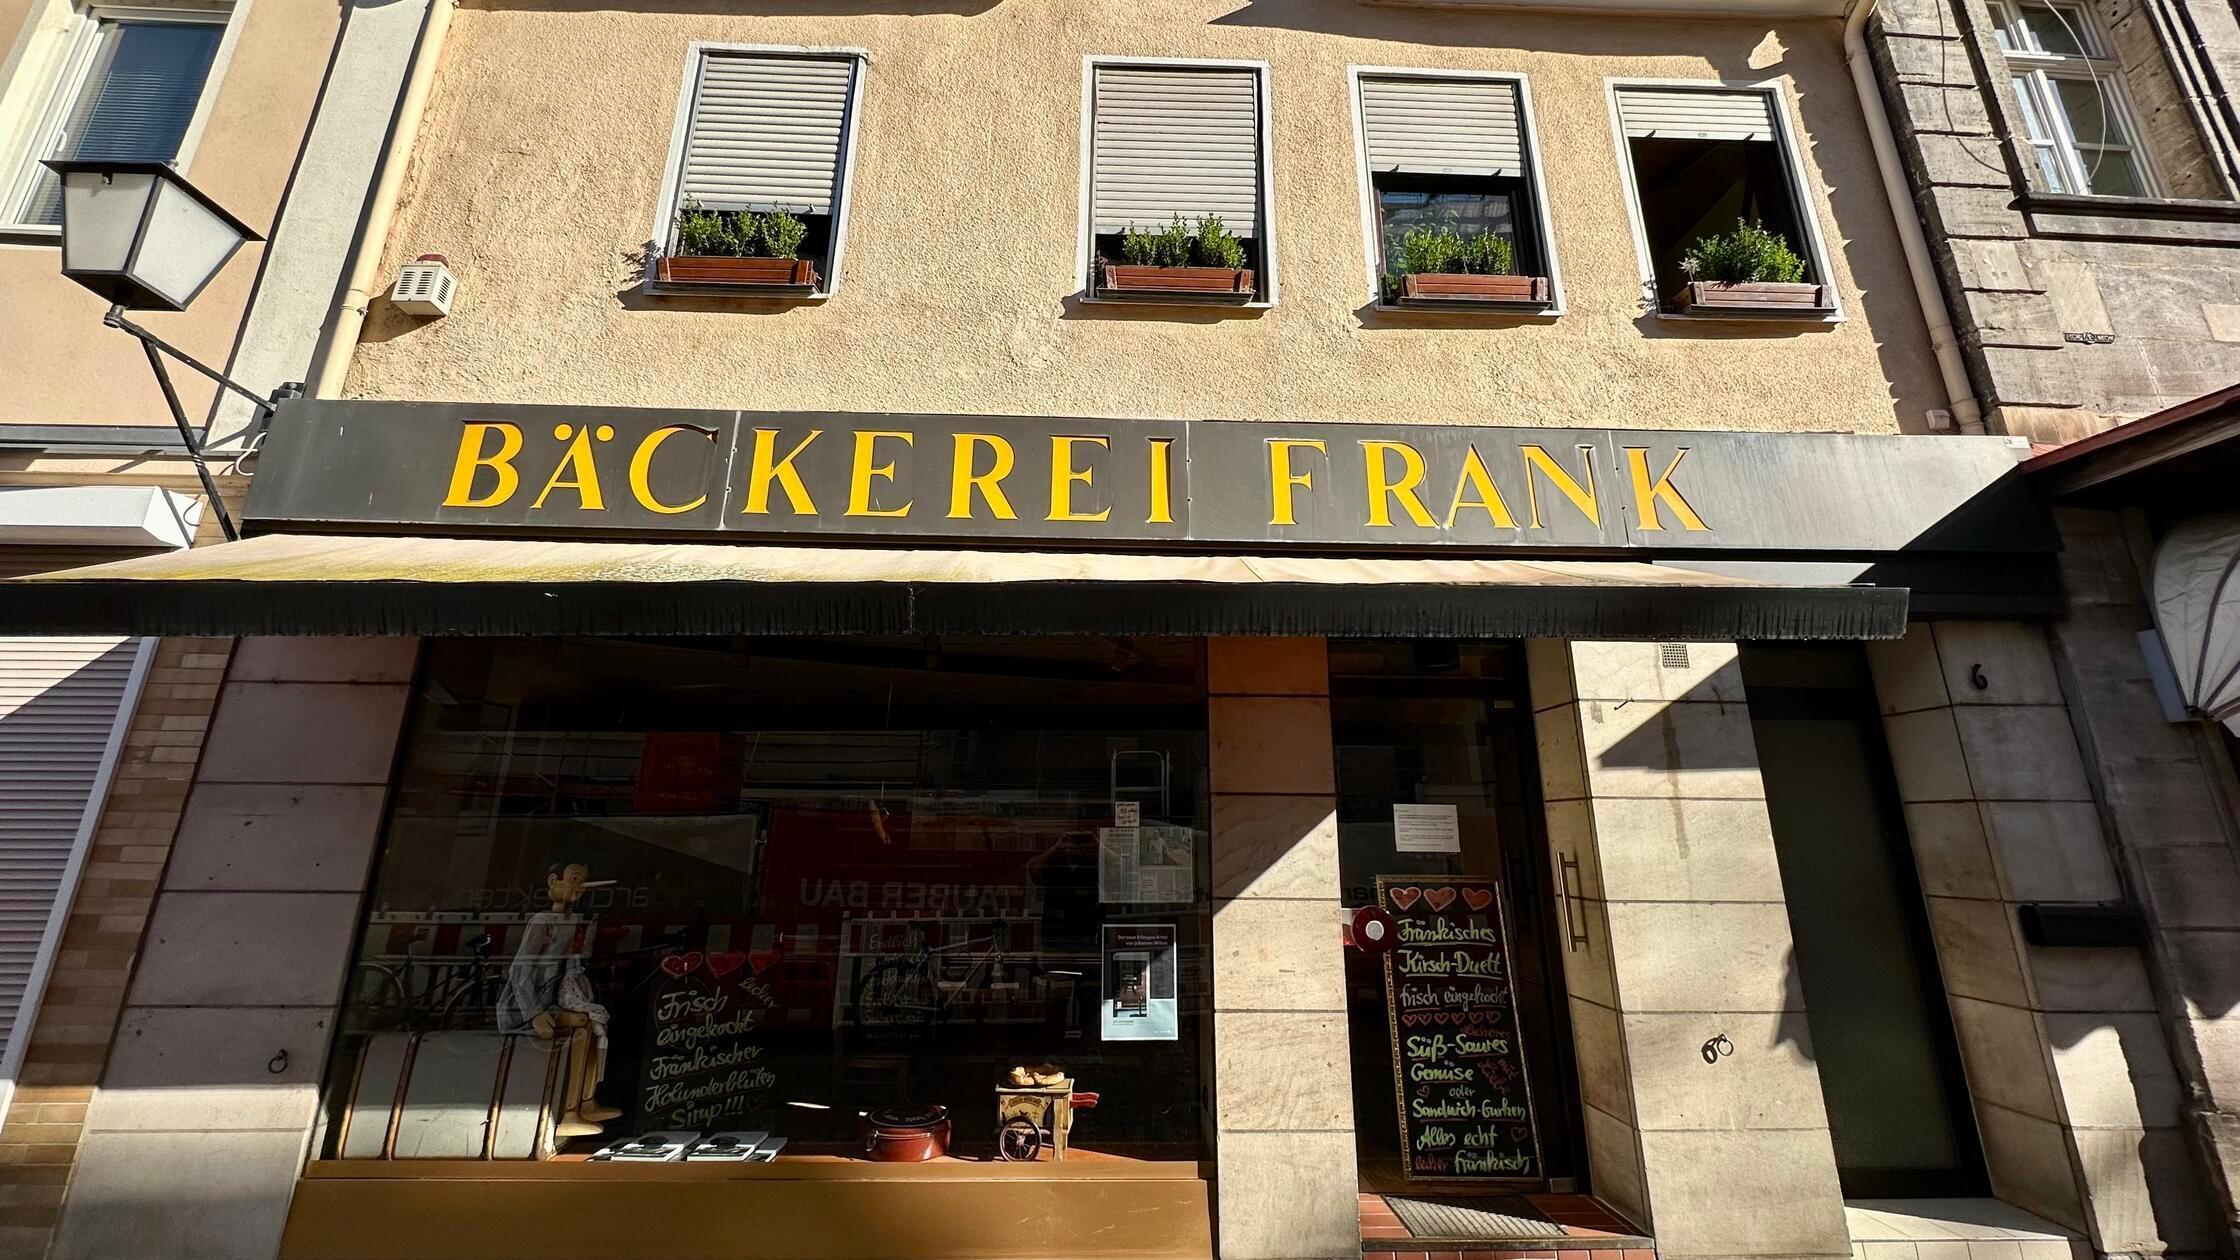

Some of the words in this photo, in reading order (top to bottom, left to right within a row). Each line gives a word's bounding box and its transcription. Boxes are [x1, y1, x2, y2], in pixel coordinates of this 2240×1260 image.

[442, 419, 1173, 524] BÄCKEREI
[1263, 437, 1713, 532] FRANK
[1970, 663, 1989, 690] 6
[1397, 918, 1496, 942] Fränkisches
[1397, 950, 1503, 975] Kirsch-Duett
[657, 986, 729, 1021] Frisch
[1400, 983, 1440, 1007] frisch
[656, 1010, 756, 1050] eingekocht
[1406, 1034, 1509, 1058] Süß-Saures
[649, 1042, 765, 1080] Fränkischer
[1411, 1060, 1474, 1082] Gemüse
[1449, 1084, 1477, 1098] oder
[1412, 1098, 1526, 1120] Sandwich-Gurken
[1416, 1125, 1456, 1151] Alles
[1463, 1125, 1498, 1147] echt
[1454, 1149, 1530, 1175] fränkisch
